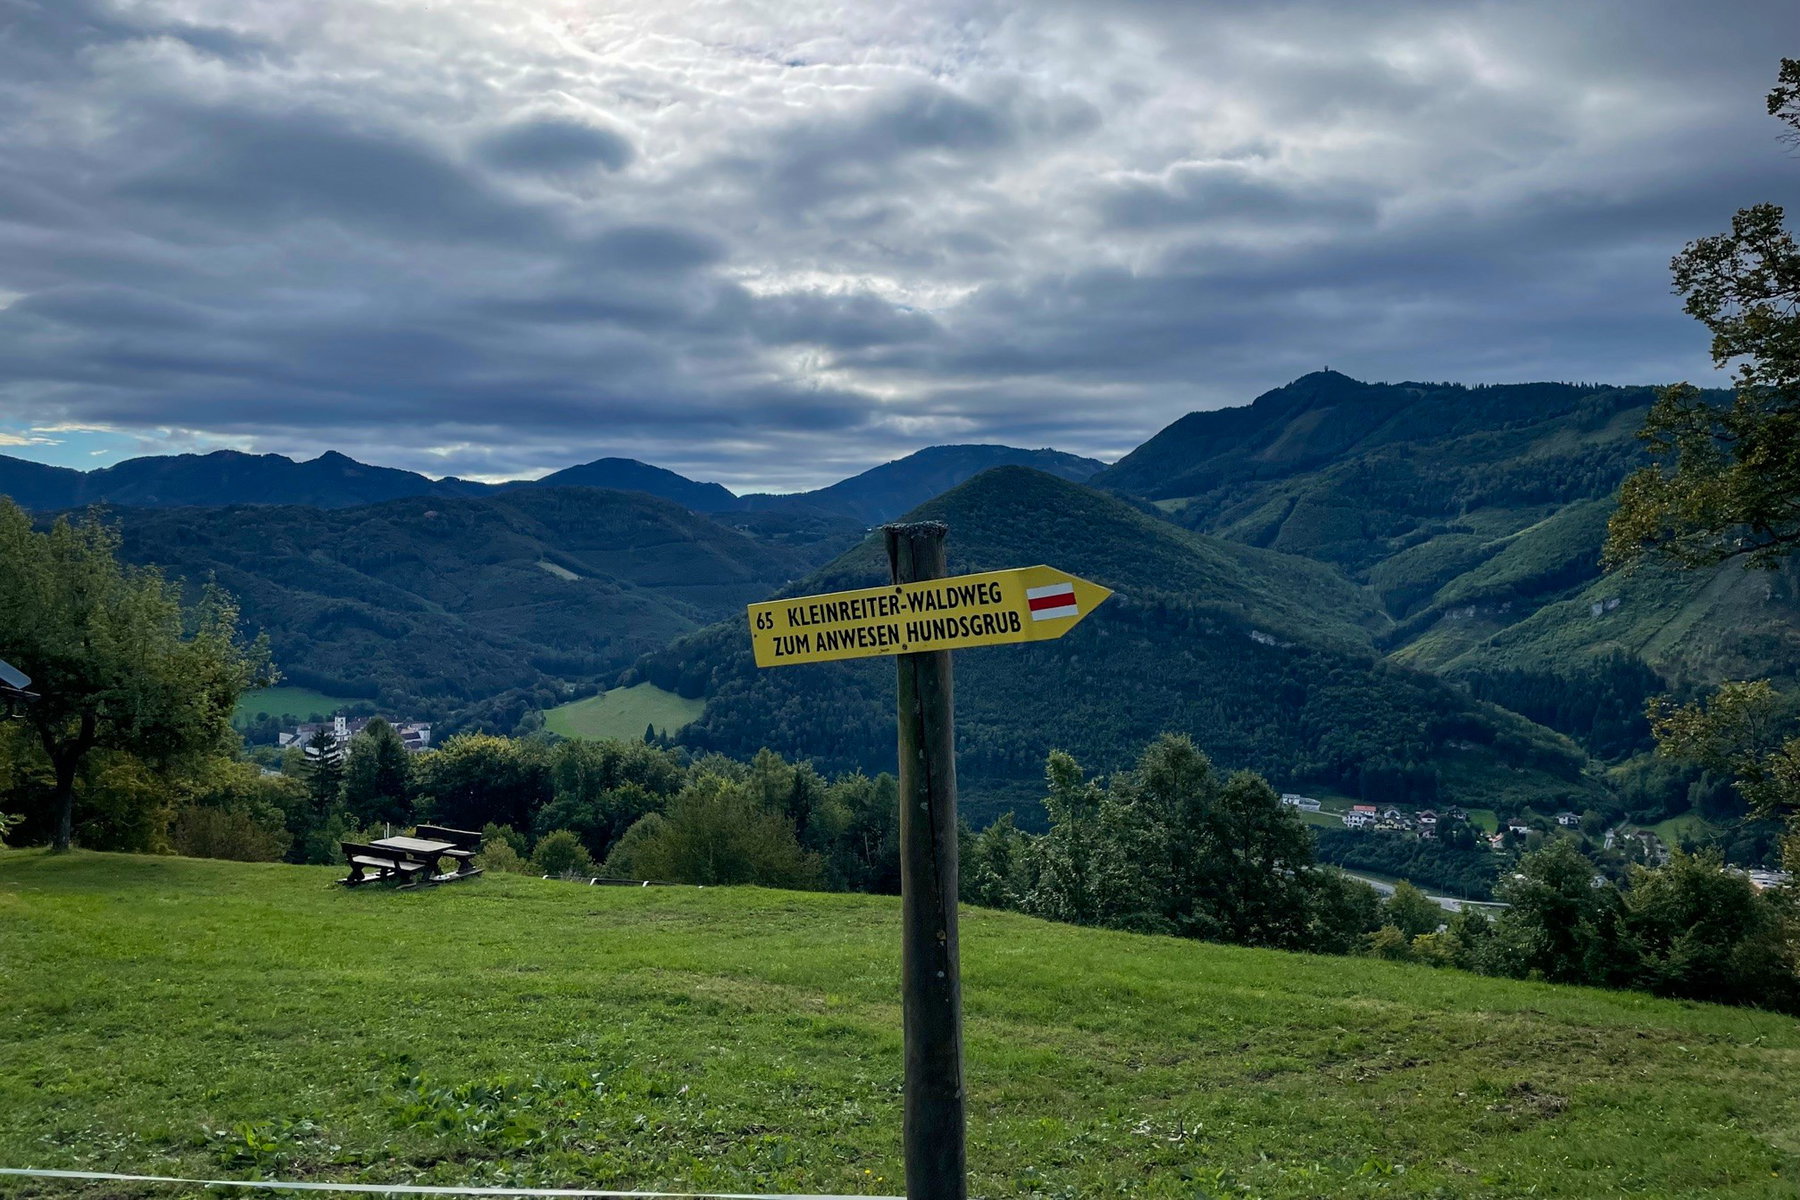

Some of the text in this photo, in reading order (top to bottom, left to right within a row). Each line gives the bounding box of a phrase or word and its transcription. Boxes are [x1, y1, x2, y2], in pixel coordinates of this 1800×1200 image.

[756, 582, 1003, 630] 65 KLEINREITER-WALDWEG
[772, 611, 1022, 657] ZUM ANWESEN HUNDSGRUB
